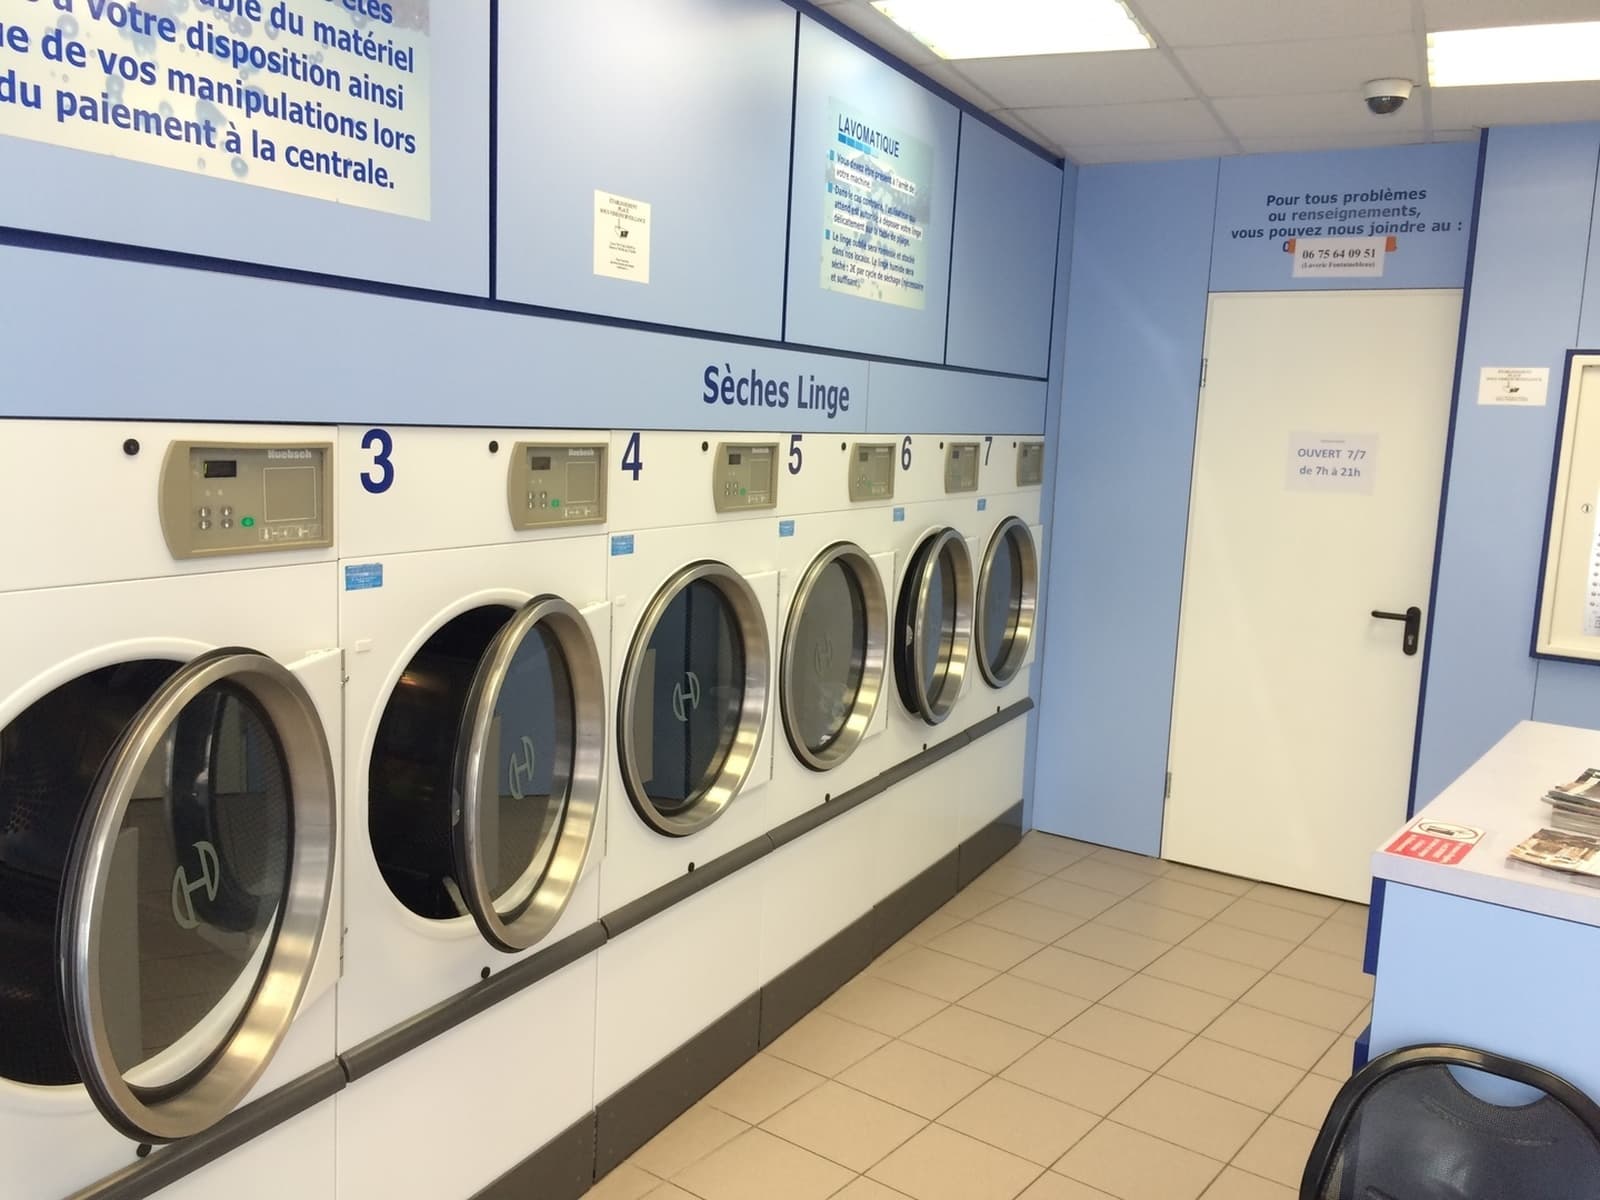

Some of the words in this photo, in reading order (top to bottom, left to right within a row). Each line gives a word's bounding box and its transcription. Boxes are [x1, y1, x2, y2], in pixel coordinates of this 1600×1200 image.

[87, 0, 176, 42] votre
[187, 21, 340, 92] disposition
[348, 73, 403, 110] ainsi
[270, 2, 304, 36] du
[314, 20, 413, 73] matériel
[42, 29, 86, 67] de
[97, 49, 156, 85] vos
[167, 68, 367, 141] manipulations
[374, 118, 416, 154] lors
[0, 69, 41, 109] du
[56, 89, 216, 148] paiement
[225, 122, 241, 154] à
[252, 129, 275, 162] la
[285, 145, 394, 189] centrale.
[838, 113, 900, 158] LAVOMATIQUE
[1266, 195, 1300, 206] Pour
[1305, 193, 1338, 205] tous
[1343, 188, 1427, 205] problèmes
[1268, 212, 1286, 222] ou
[1292, 205, 1421, 221] renseignements,
[1232, 229, 1264, 239] vous
[1269, 226, 1322, 241] pouvez
[1327, 224, 1364, 236] nous
[1368, 220, 1426, 237] joindre
[1431, 222, 1451, 232] au
[1302, 250, 1315, 259] 06
[1318, 249, 1330, 259] 75
[1332, 249, 1345, 259] 64
[1349, 249, 1362, 258] 09
[1364, 248, 1376, 258] 51
[703, 363, 789, 408] Sèches
[797, 375, 850, 419] Linge
[360, 428, 395, 494] 3
[621, 432, 643, 481] 4
[788, 434, 803, 475] 5
[901, 435, 913, 471] 6
[984, 436, 993, 466] 7
[1297, 448, 1342, 458] OUVERT
[1348, 449, 1366, 461] 7/7
[1299, 465, 1312, 475] de
[1316, 466, 1329, 476] 7h
[1331, 467, 1338, 476] à
[1340, 467, 1360, 477] 21h
